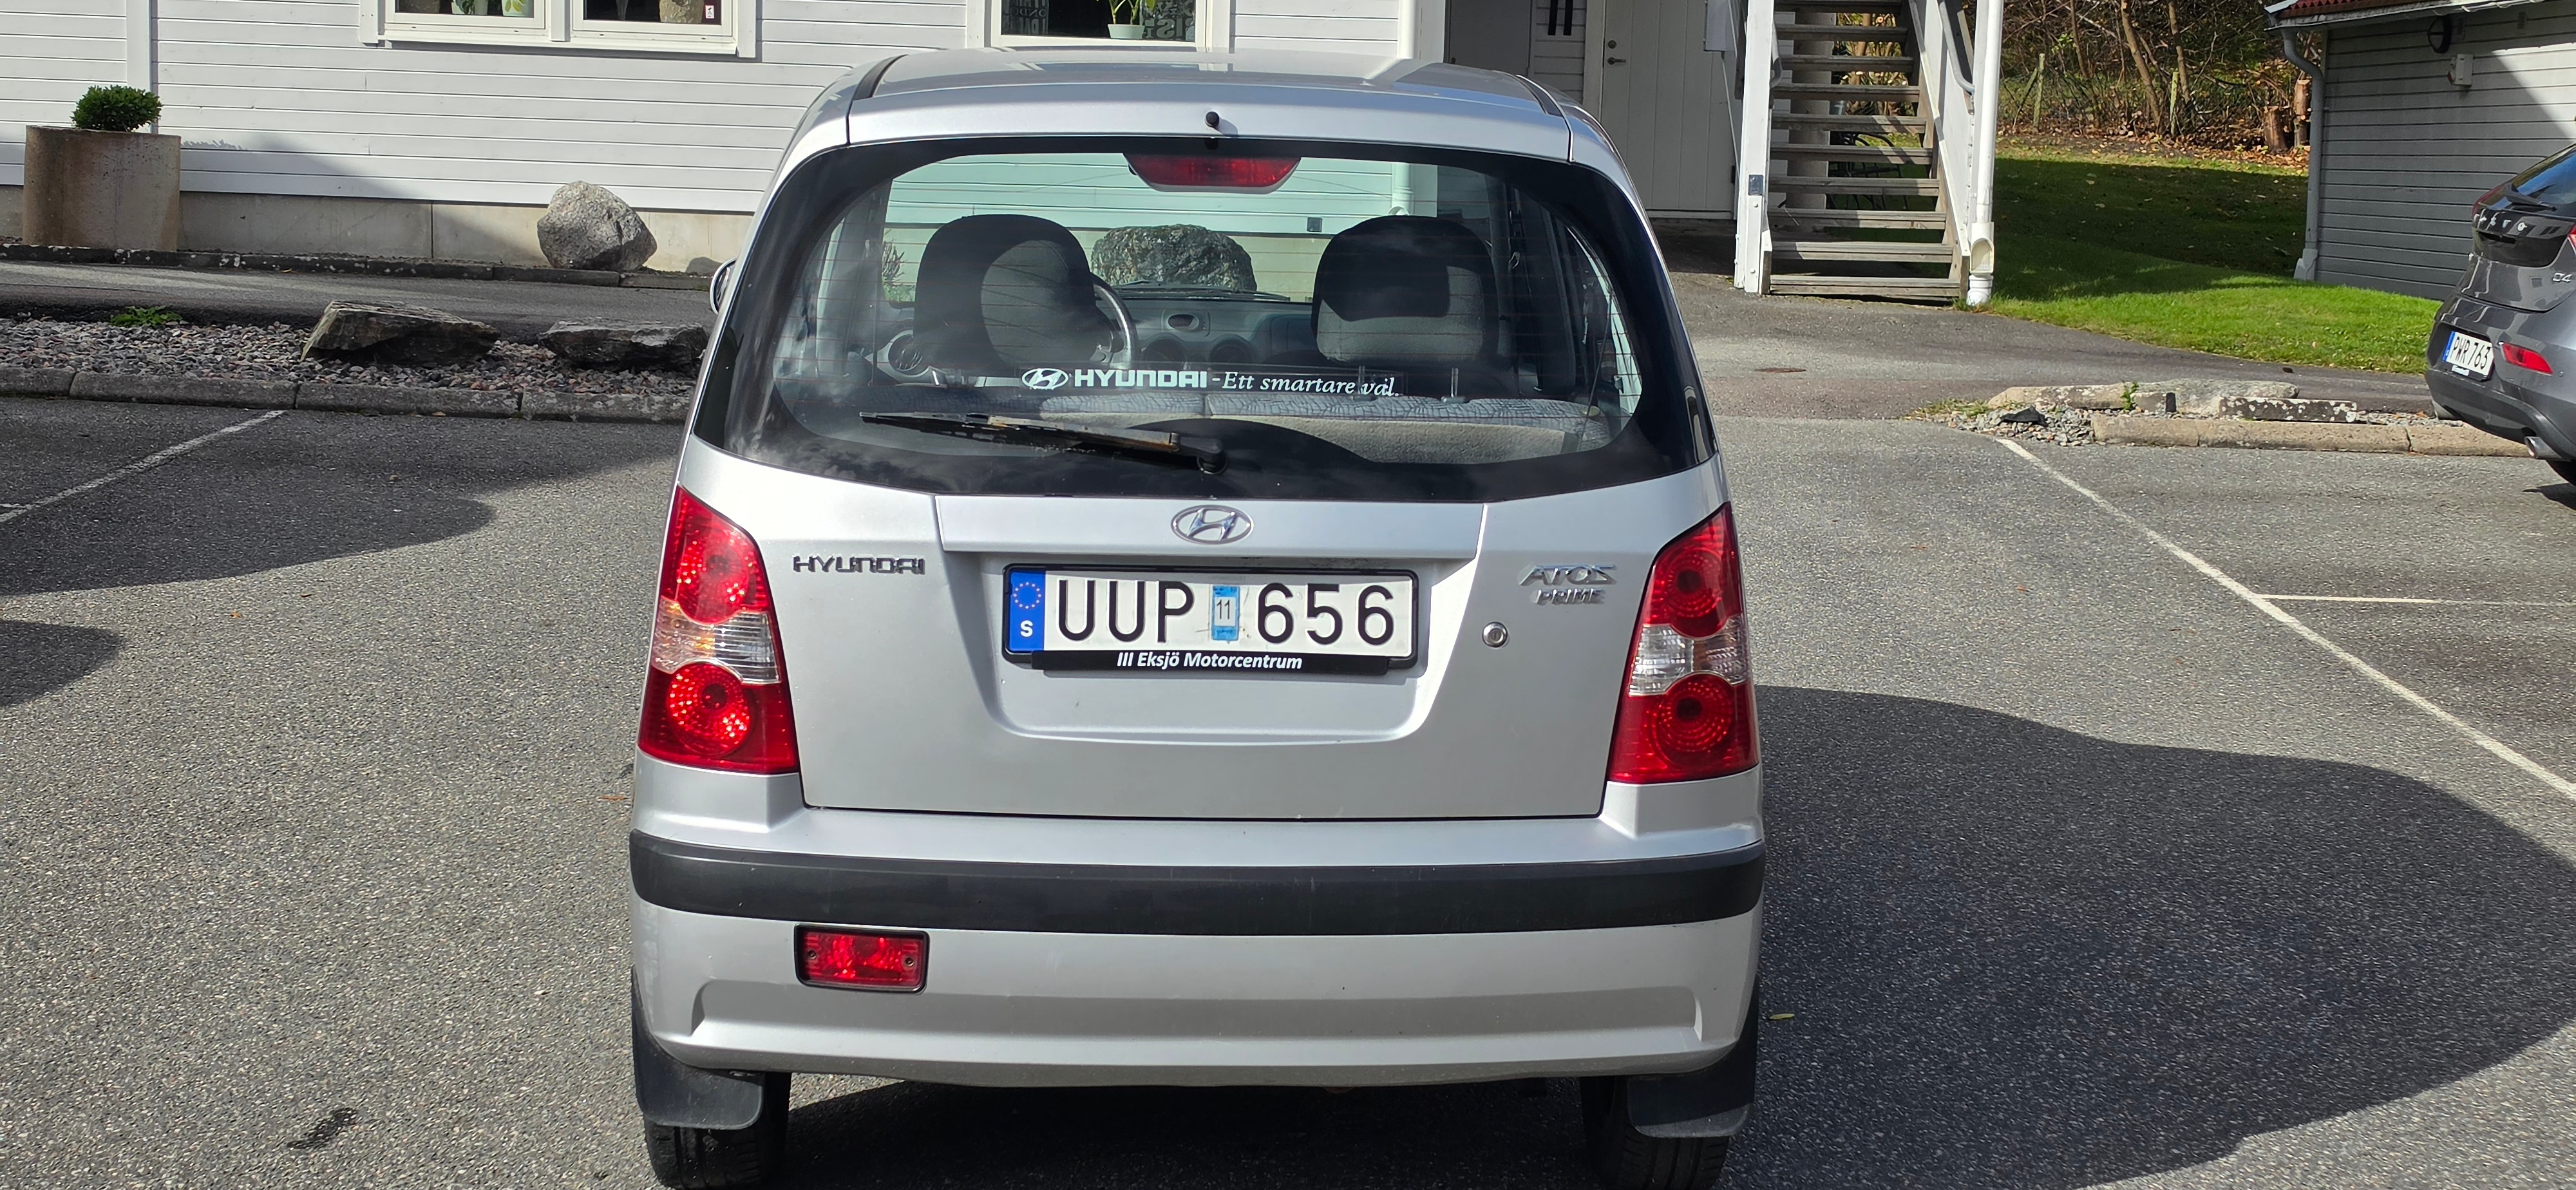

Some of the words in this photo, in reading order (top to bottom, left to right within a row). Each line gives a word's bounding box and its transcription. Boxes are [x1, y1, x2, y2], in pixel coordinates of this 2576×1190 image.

[2552, 272, 2573, 283] D4
[2467, 342, 2492, 370] 763
[1074, 370, 1207, 388] HYUNDAI
[1260, 377, 1355, 393] smartare
[1361, 377, 1399, 397] val.
[792, 555, 925, 574] HYUNDAI
[1517, 565, 1617, 586] ATOS
[1534, 589, 1606, 605] PRIME
[1057, 579, 1195, 643] UUP
[1257, 582, 1395, 646] 656
[1216, 599, 1230, 620] 11
[1020, 619, 1034, 637] S
[1137, 652, 1180, 670] Eksjö
[1184, 653, 1302, 669] Motorcentrum
